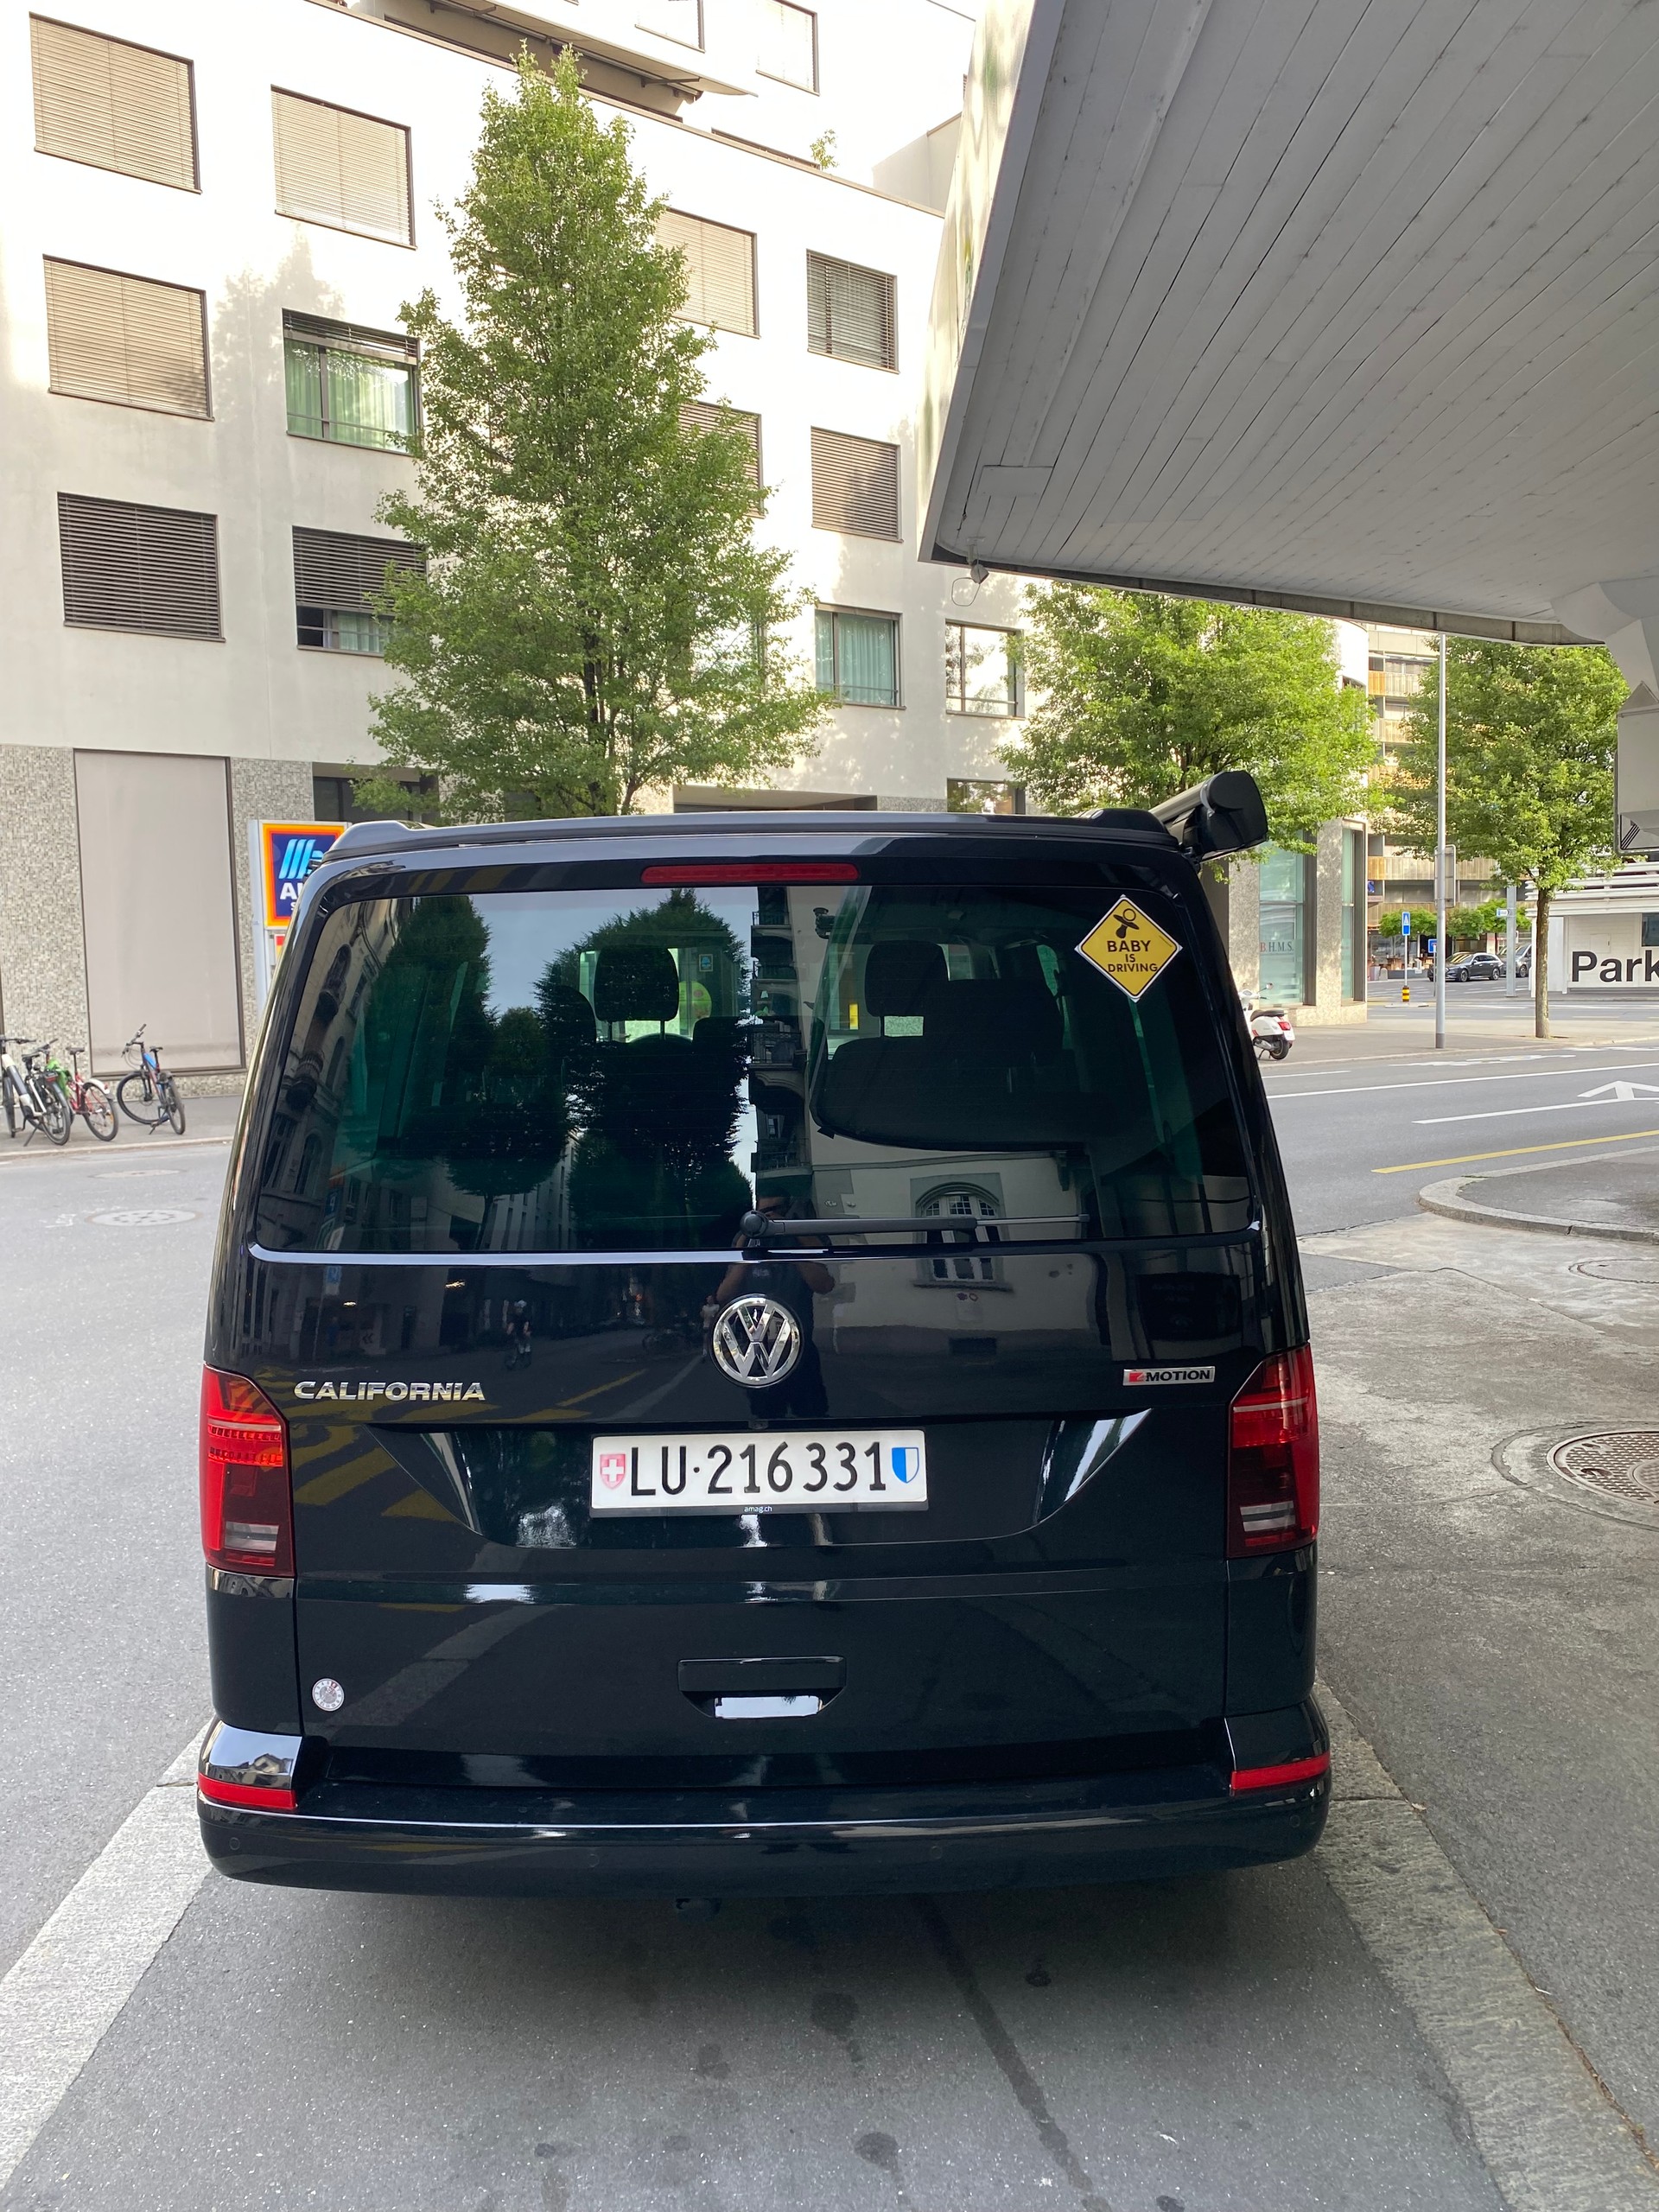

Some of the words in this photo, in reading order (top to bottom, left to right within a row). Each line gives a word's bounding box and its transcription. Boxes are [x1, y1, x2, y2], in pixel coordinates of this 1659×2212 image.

[1107, 940, 1151, 951] BABY
[1125, 954, 1135, 963] IS
[1108, 963, 1158, 972] DRIVING
[1572, 950, 1659, 982] Park
[294, 1381, 486, 1402] CALIFORNIA
[744, 1505, 772, 1514] amag.ch
